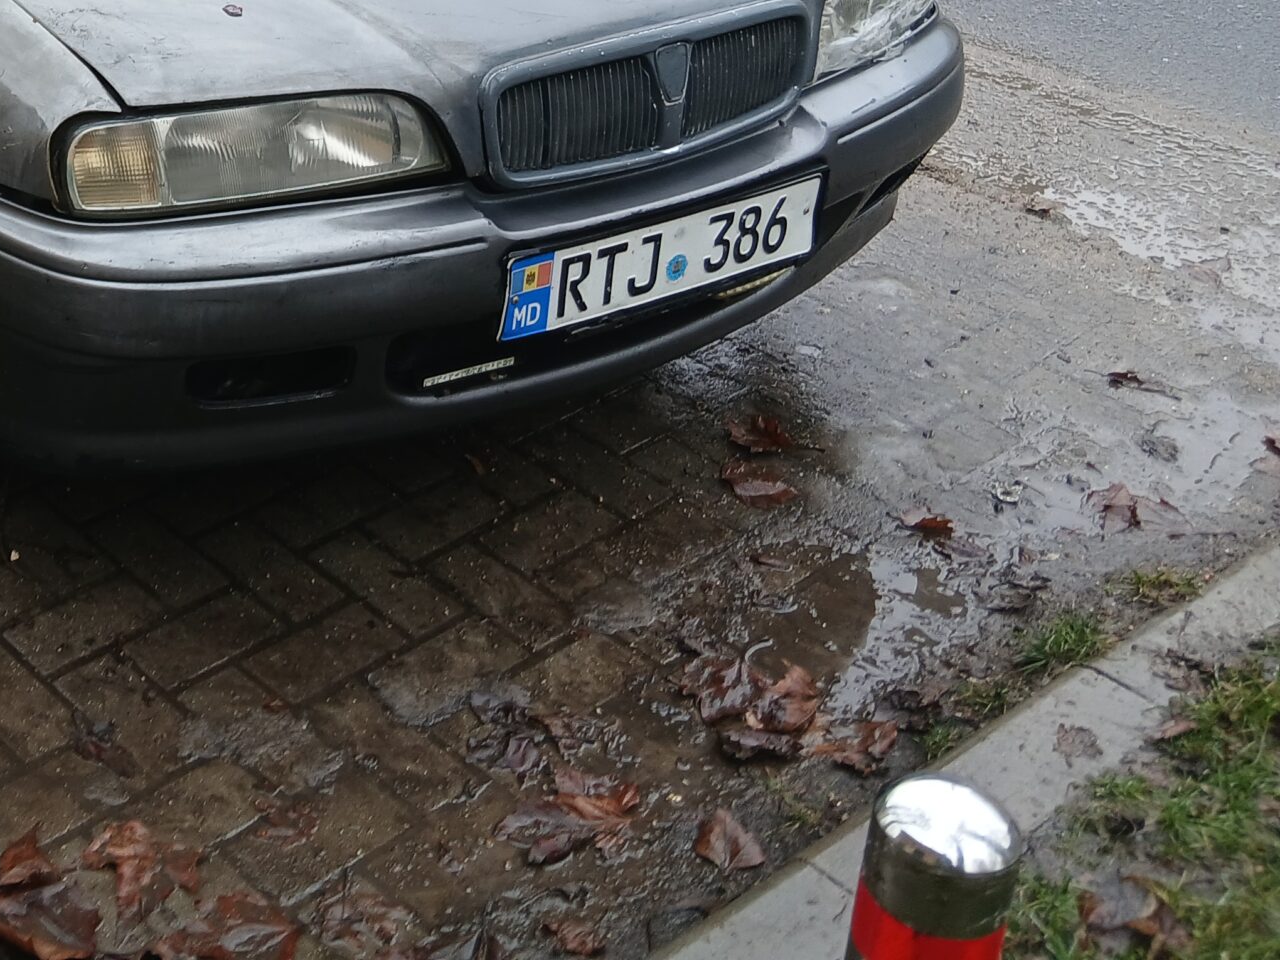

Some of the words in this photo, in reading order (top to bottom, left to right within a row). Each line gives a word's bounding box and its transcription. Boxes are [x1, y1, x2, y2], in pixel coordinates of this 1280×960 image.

[556, 232, 663, 318] RTJ
[703, 195, 787, 273] 386
[511, 302, 541, 330] MD
